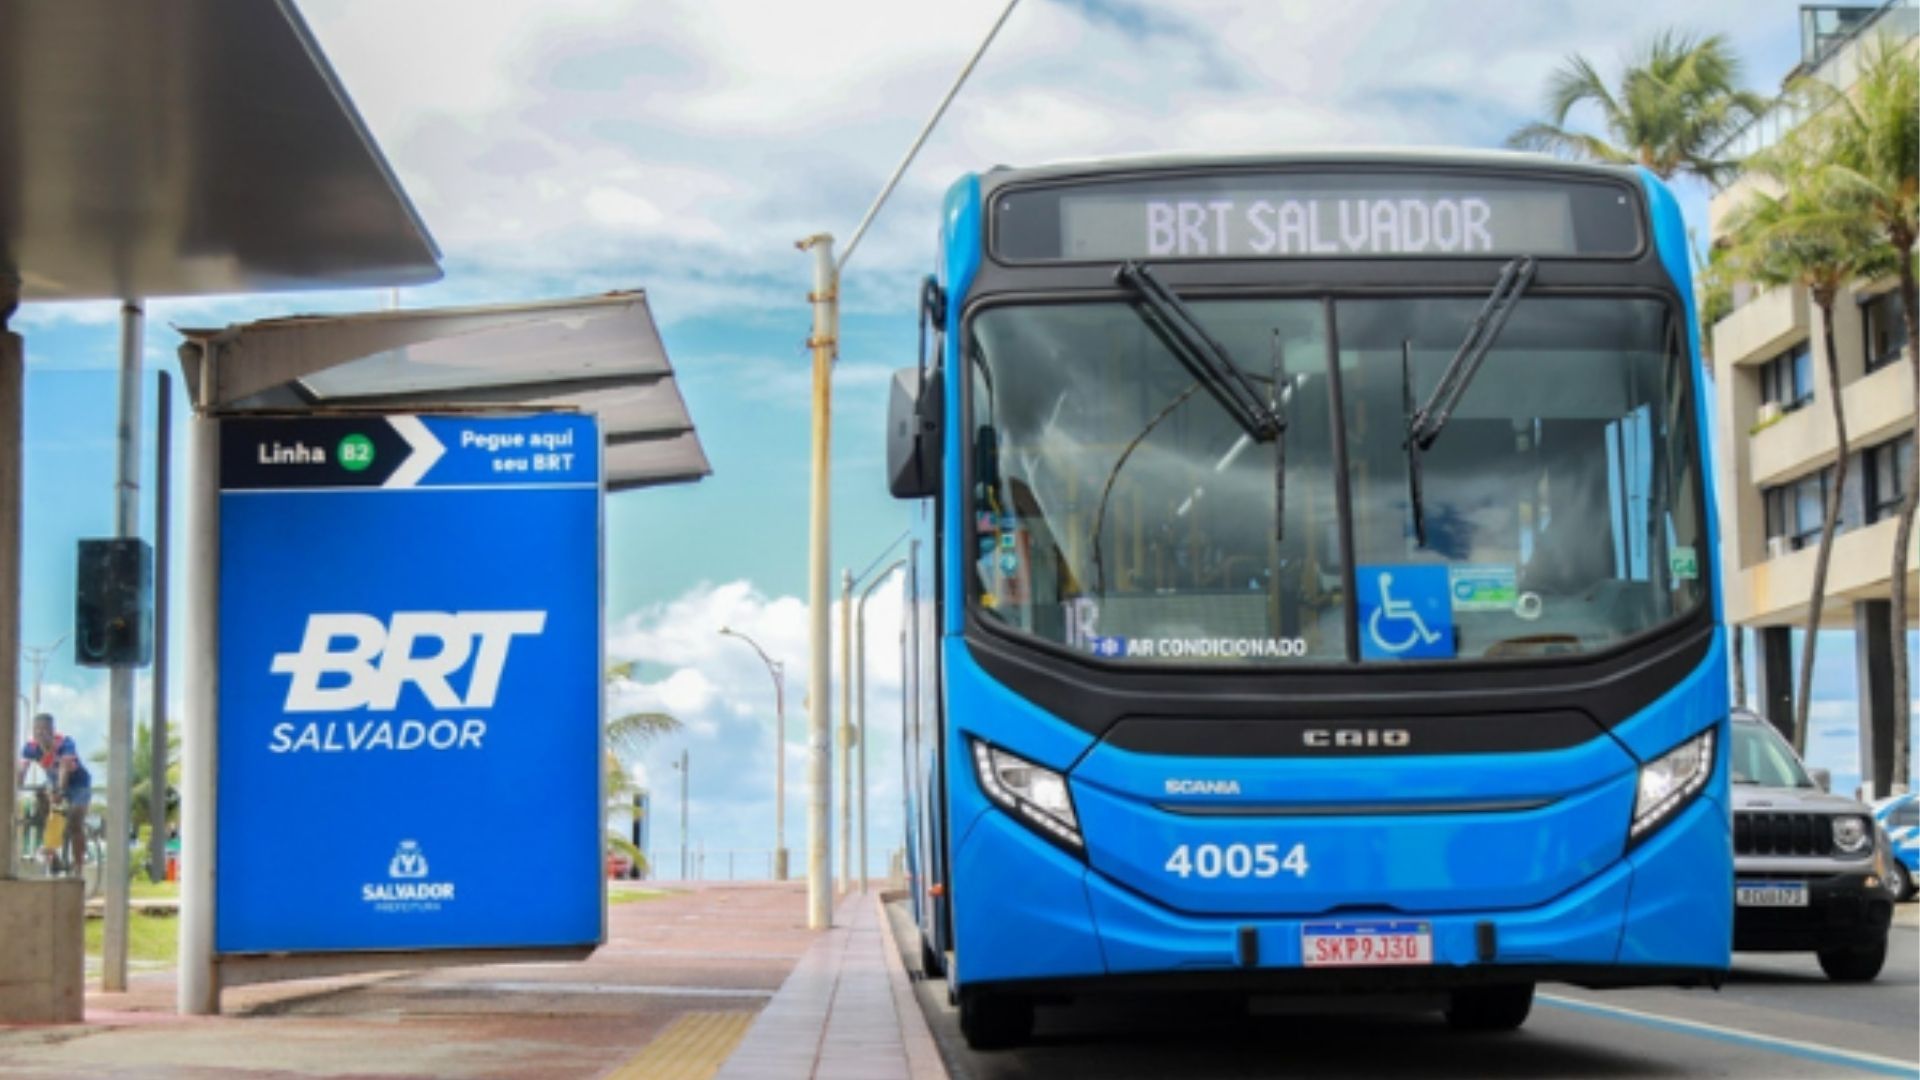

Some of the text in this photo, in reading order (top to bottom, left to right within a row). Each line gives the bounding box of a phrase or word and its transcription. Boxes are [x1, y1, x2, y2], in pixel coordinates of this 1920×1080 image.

[1146, 198, 1493, 255] BRT SALVADOR
[461, 428, 574, 452] Pegue aqui
[258, 442, 370, 464] Linha B2
[492, 453, 575, 472] seu BRT
[1126, 638, 1308, 657] AR CONDICIONADO
[270, 609, 547, 713] BRT
[269, 719, 487, 753] SALVADOR
[1303, 729, 1411, 747] CAIO
[1164, 779, 1241, 795] SCANIA
[1165, 843, 1310, 879] 40054
[362, 882, 456, 901] SALVADOR
